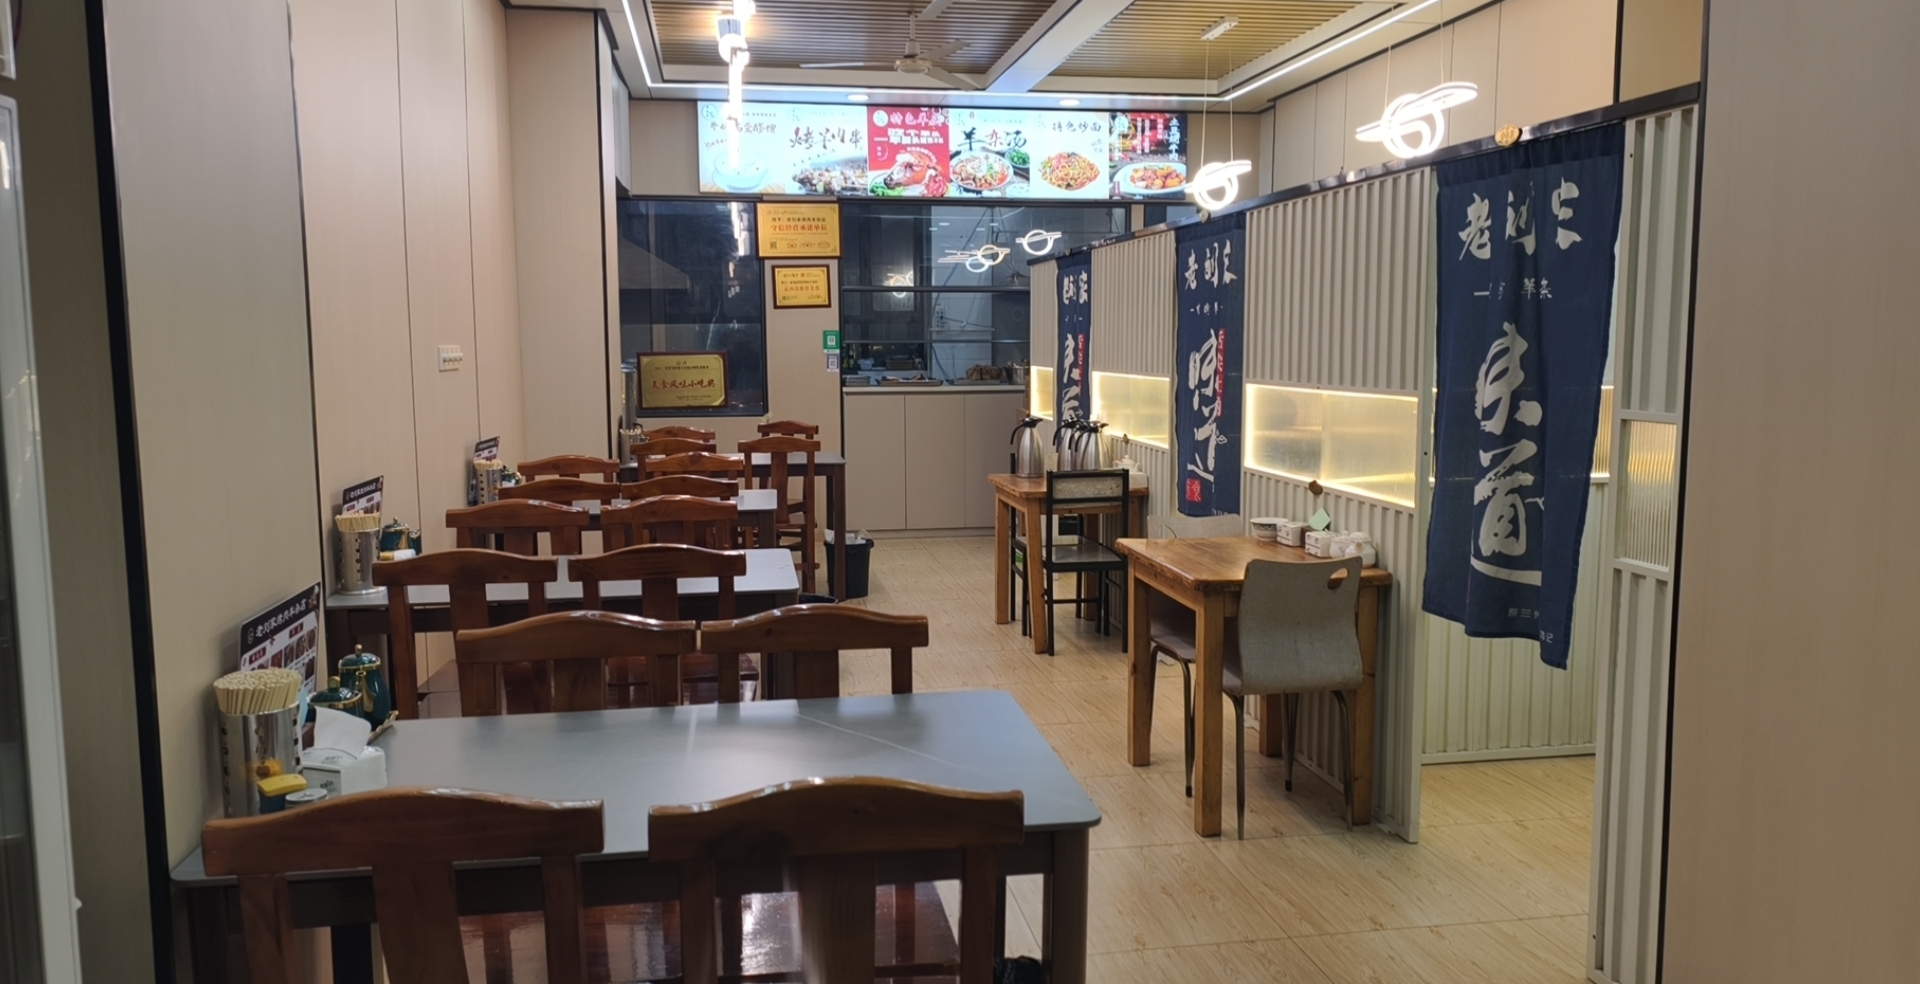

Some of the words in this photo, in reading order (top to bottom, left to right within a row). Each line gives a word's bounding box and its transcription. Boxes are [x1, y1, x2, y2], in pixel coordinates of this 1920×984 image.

[789, 126, 863, 150] 烤羊肉串
[1051, 120, 1102, 133] 特色炒面
[1168, 116, 1181, 161] 土豆烧牛肉
[957, 127, 1028, 151] 羊杂汤
[771, 224, 827, 232] 守信经营承诺单位
[1184, 239, 1238, 290] 老刘家
[652, 379, 716, 389] 美食风味小吃奖
